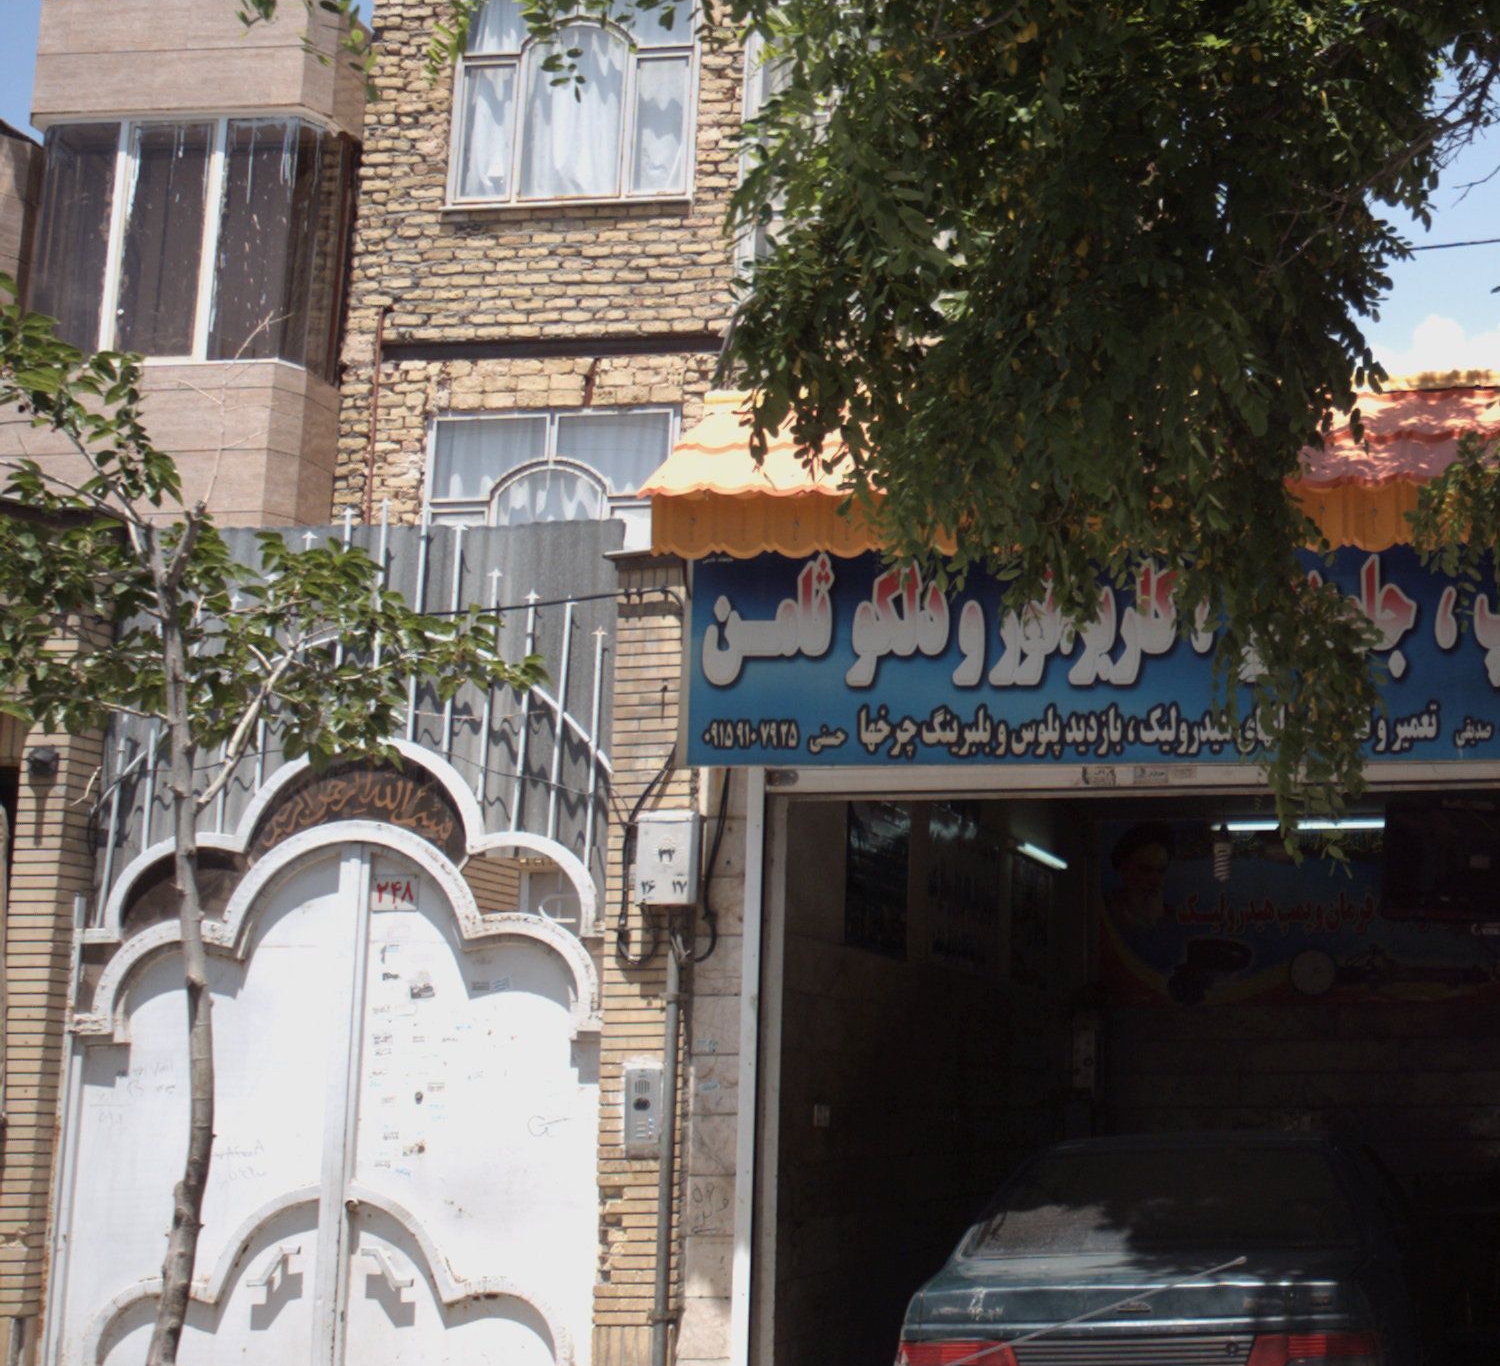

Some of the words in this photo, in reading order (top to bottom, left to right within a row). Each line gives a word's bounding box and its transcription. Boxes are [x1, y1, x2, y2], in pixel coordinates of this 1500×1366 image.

[701, 552, 836, 685] ثامن
[845, 557, 949, 687] دلکو
[951, 600, 985, 687] و
[858, 705, 918, 759] چرخها
[921, 704, 992, 756] بلبرینگ
[995, 721, 1008, 756] و
[1011, 705, 1060, 758] پلوس
[1065, 704, 1121, 756] بازدید
[1392, 701, 1438, 752] تعمیر
